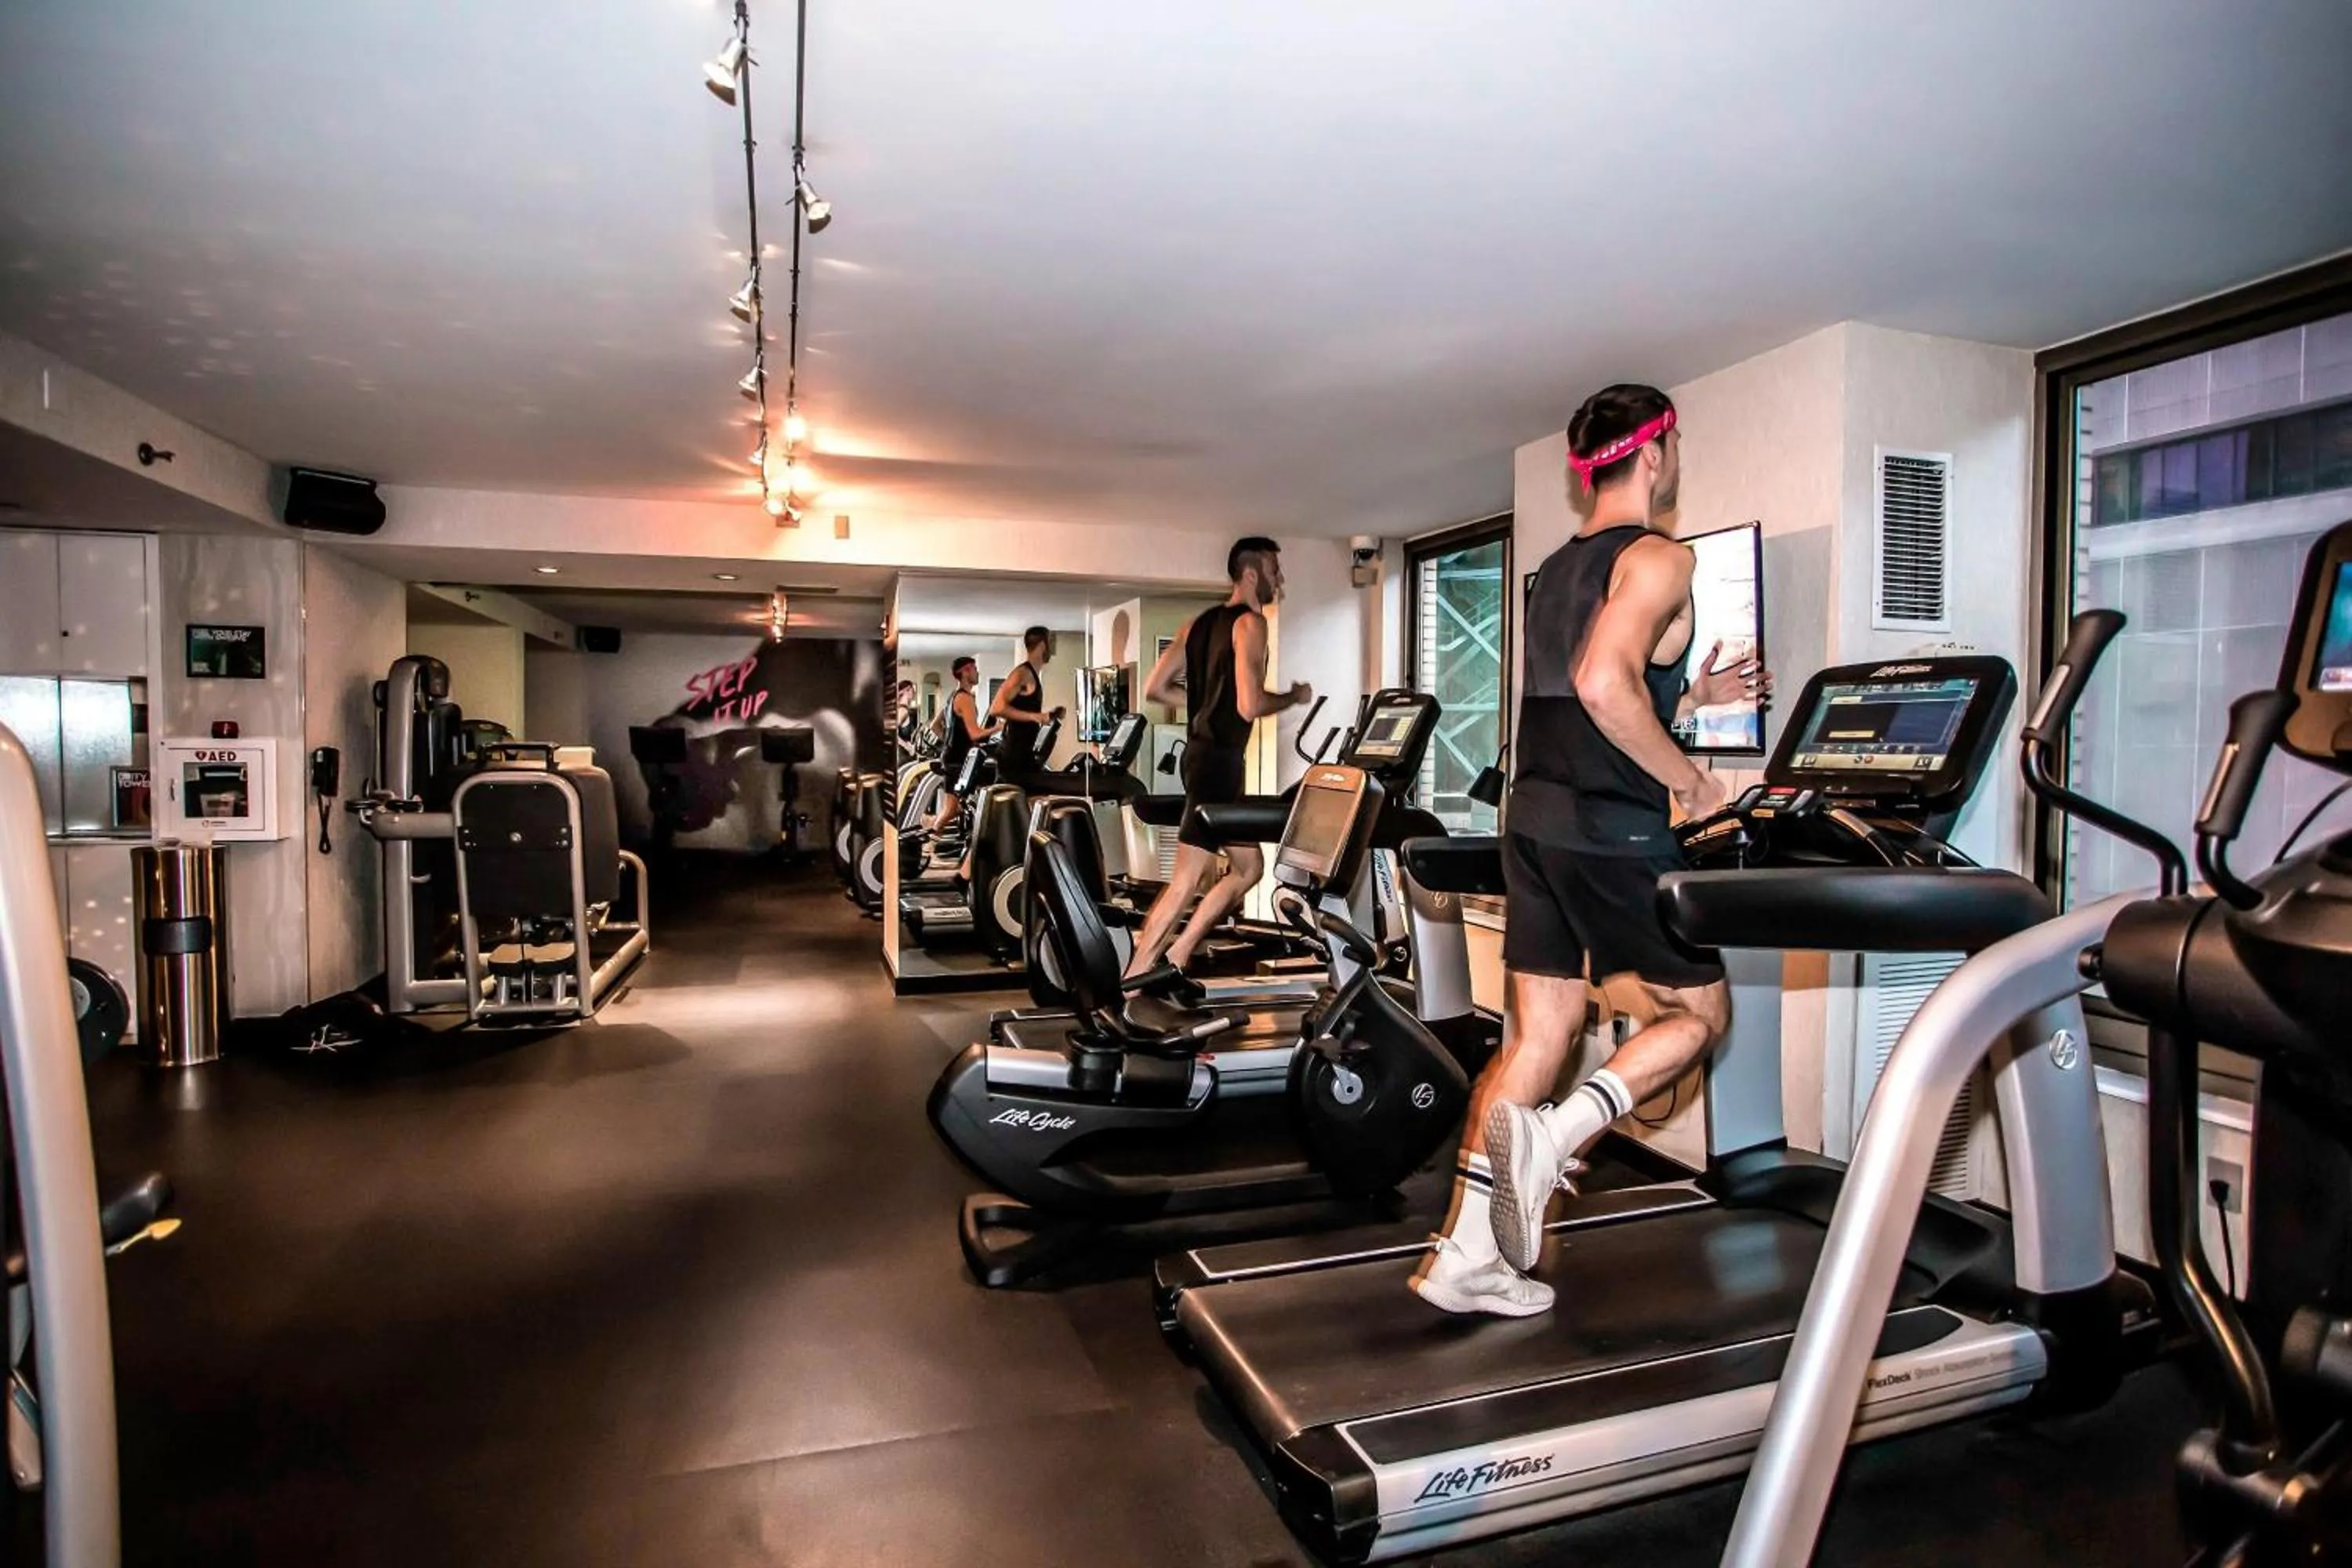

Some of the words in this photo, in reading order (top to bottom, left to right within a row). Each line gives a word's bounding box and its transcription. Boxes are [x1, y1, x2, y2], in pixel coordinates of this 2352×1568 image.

[686, 656, 757, 710] STEP
[714, 699, 737, 728] IT
[741, 691, 768, 719] UP
[209, 751, 237, 760] AED
[1414, 1468, 1468, 1503] Life
[1467, 1454, 1555, 1493] Fitness
